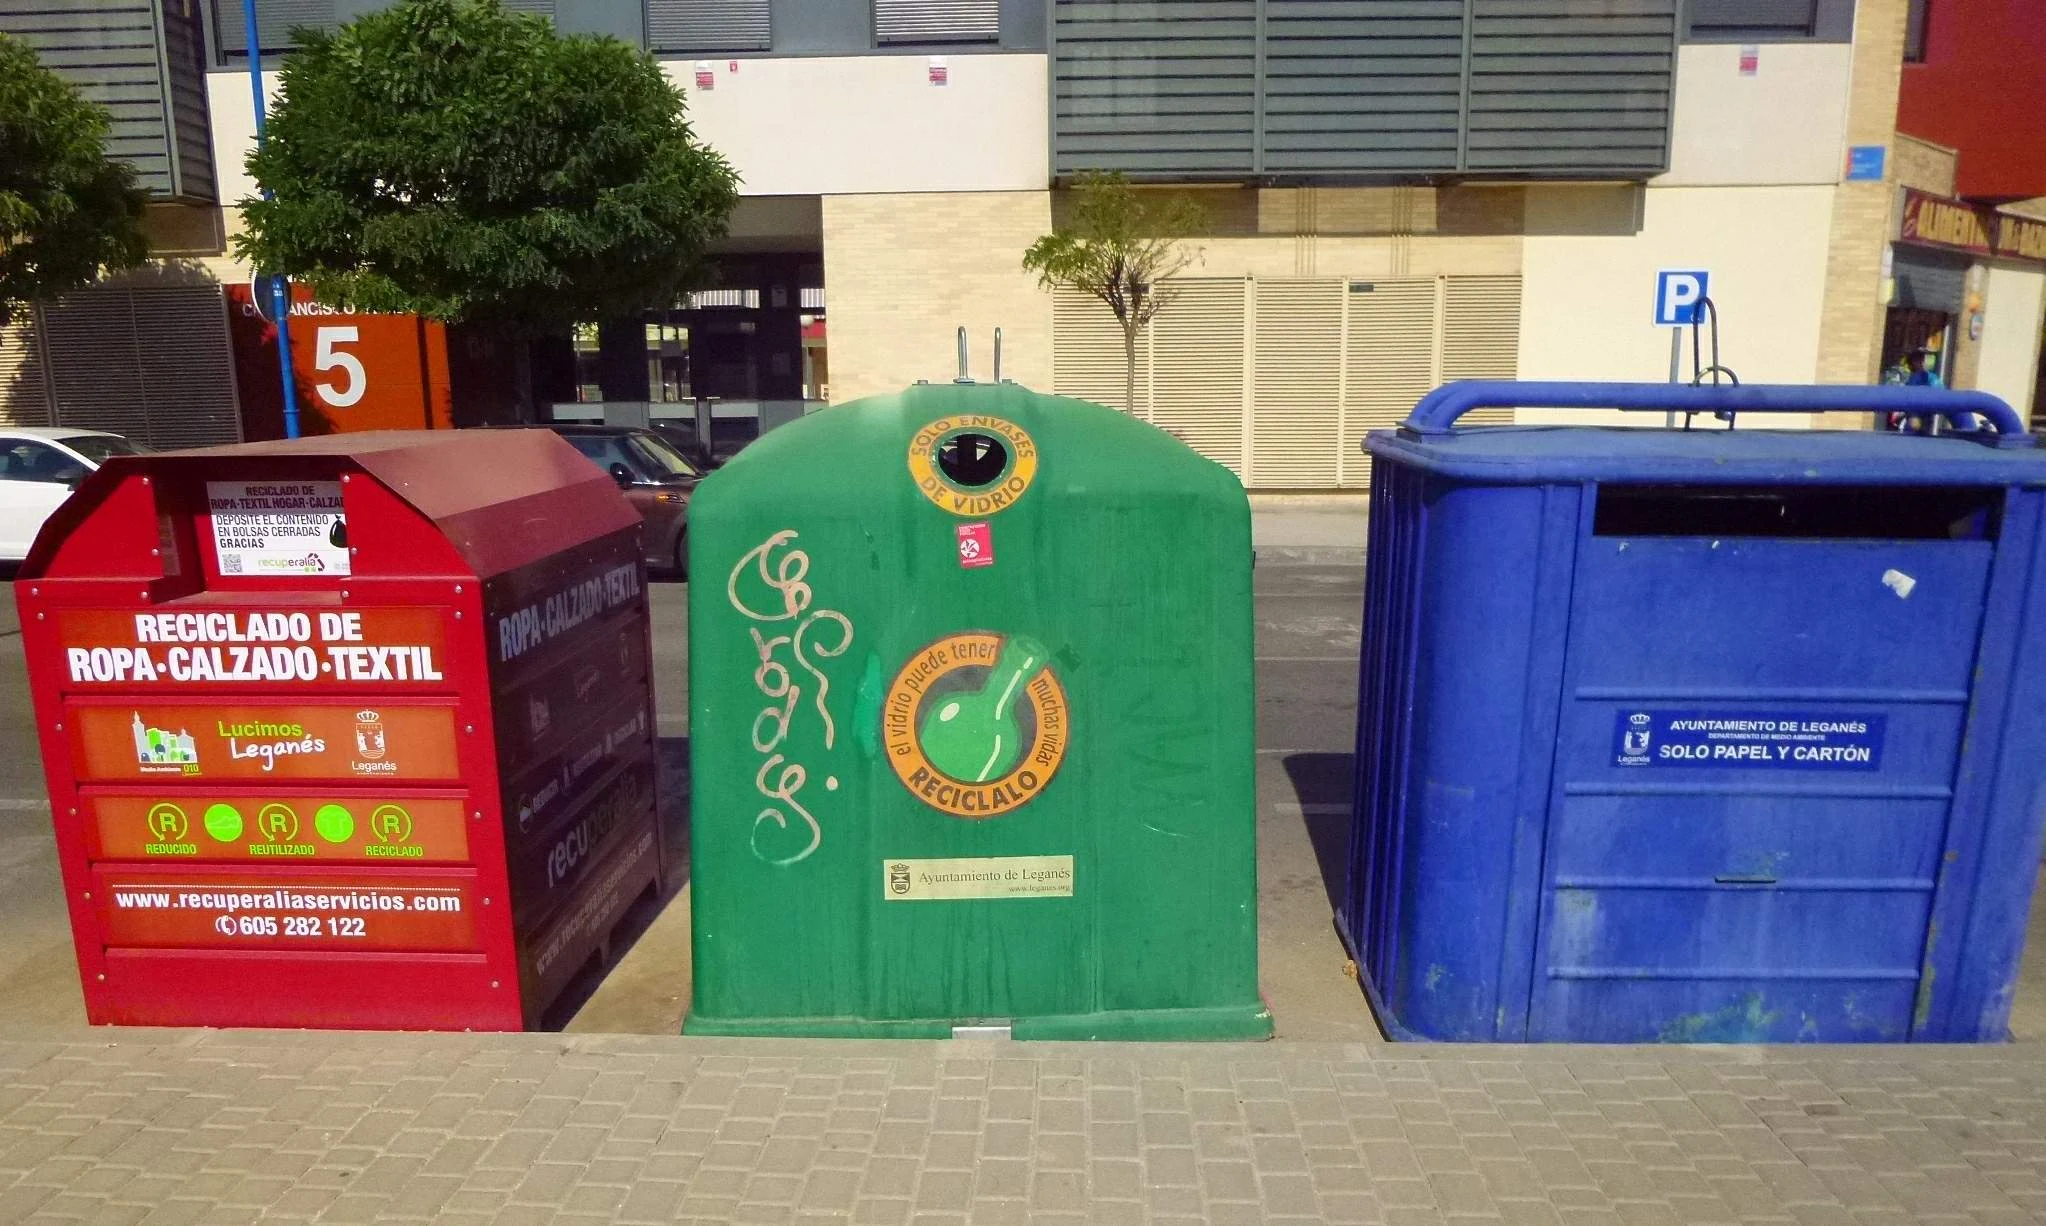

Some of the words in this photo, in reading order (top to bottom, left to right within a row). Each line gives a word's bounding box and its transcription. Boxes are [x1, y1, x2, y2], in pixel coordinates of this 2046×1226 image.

[1663, 274, 1700, 321] P
[315, 326, 367, 407] 5
[911, 420, 951, 457] SOLO
[961, 416, 1034, 458] ENVASES
[245, 485, 299, 496] RECICLADO
[302, 485, 315, 495] DE
[921, 477, 945, 502] DE
[953, 476, 1025, 514] VIDRIO
[216, 514, 261, 526] DEPOSITE
[262, 515, 275, 525] EL
[276, 515, 329, 525] CONTENIDO
[218, 527, 231, 537] EN
[233, 526, 270, 537] BOLSAS
[271, 526, 321, 537] CERRADAS
[220, 538, 265, 549] GRACIAS
[258, 555, 317, 570] recuperalia
[134, 612, 312, 643] RECICLADO
[319, 612, 363, 642] DE
[951, 641, 996, 660] tener
[904, 650, 949, 694] puede
[1031, 678, 1063, 730] muchas
[886, 692, 912, 738] vidrio
[217, 720, 303, 738] Lucimos
[1670, 719, 1776, 732] AYUNTAMIENTO
[1779, 721, 1798, 732] DE
[1801, 720, 1867, 733] LEGANÉS
[229, 734, 326, 771] Leganés
[895, 744, 912, 757] el
[1036, 732, 1063, 768] vidas
[1659, 744, 1710, 760] SOLO
[1714, 744, 1773, 760] PAPEL
[1777, 745, 1791, 760] Y
[1793, 744, 1871, 762] CARTÓN
[351, 760, 397, 772] Leganés
[908, 766, 1039, 812] RECICLALO
[159, 812, 177, 832] R
[269, 813, 288, 833] R
[382, 814, 400, 834] R
[145, 844, 197, 855] REDUCIDO
[249, 844, 316, 855] REUTILIZADO
[365, 845, 424, 857] RECICLADO
[919, 870, 1001, 885] Ayuntamiento
[1004, 869, 1019, 880] de
[1022, 867, 1071, 882] Leganés
[116, 891, 461, 912] www.recuperaliaservicios.com
[239, 916, 278, 936] 605
[283, 916, 323, 936] 282
[328, 917, 366, 937] 122
